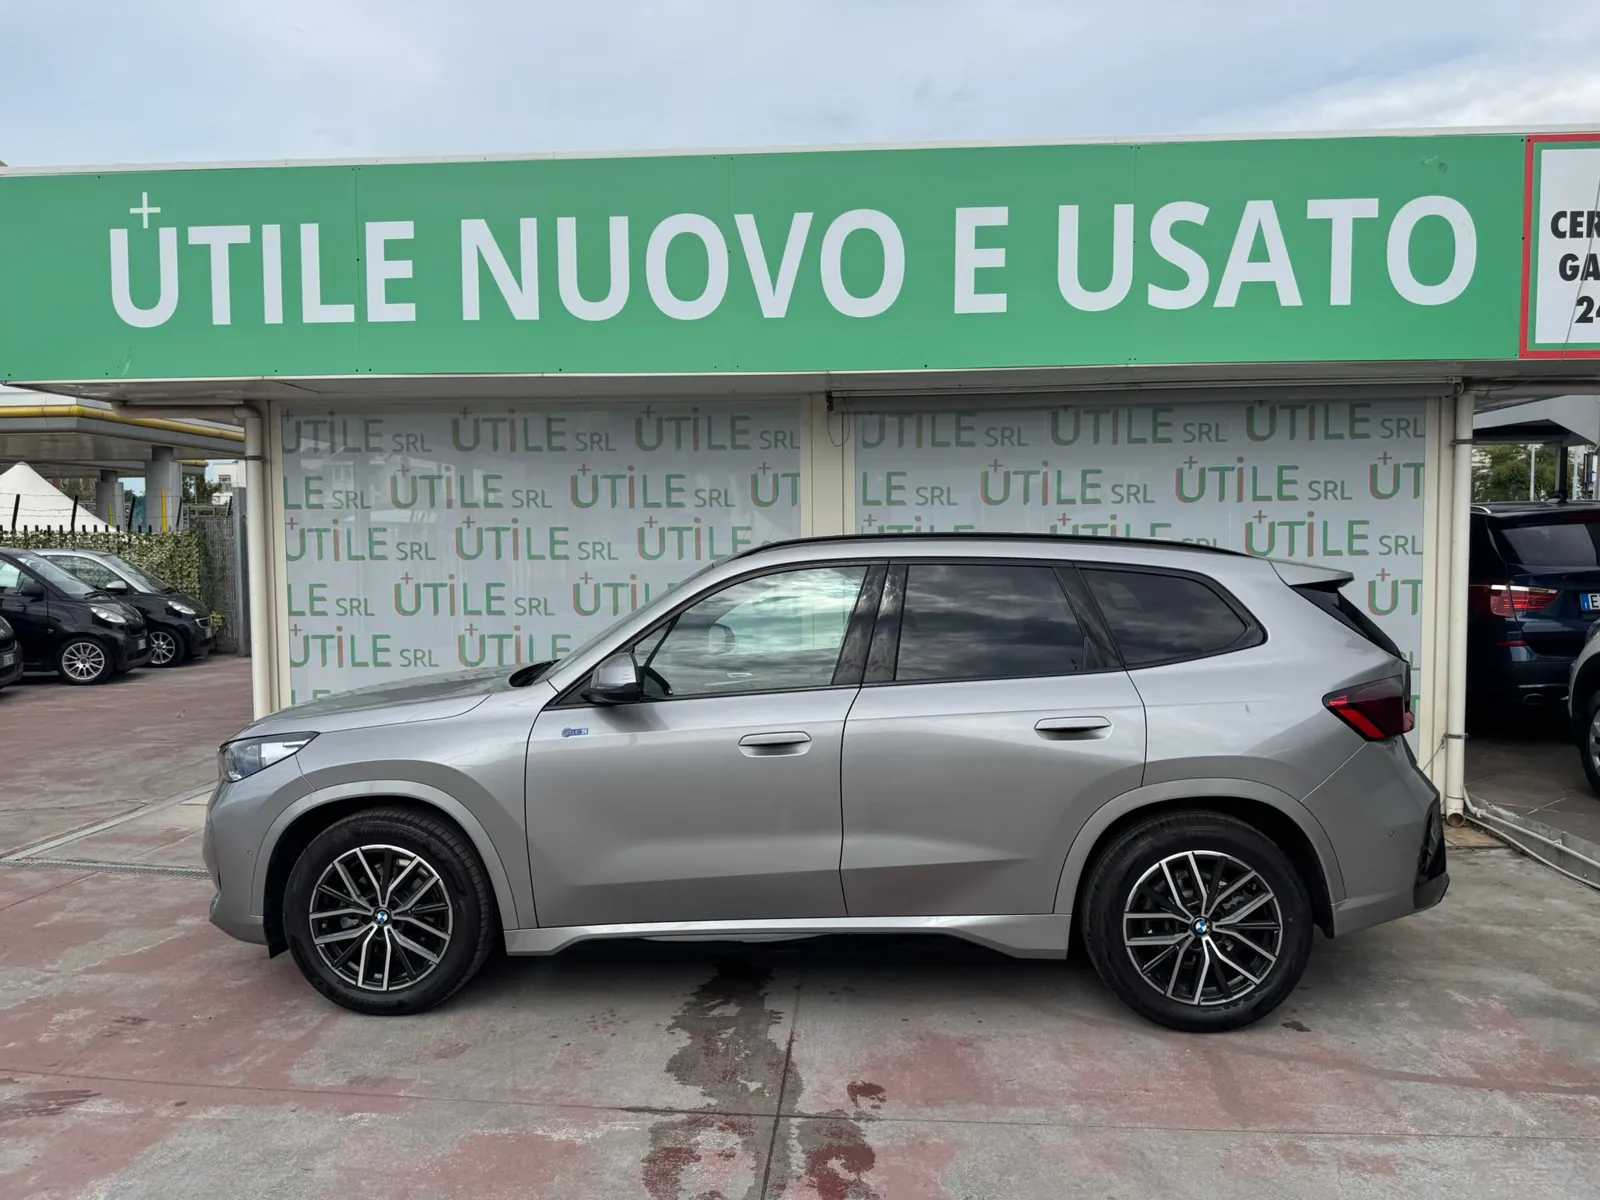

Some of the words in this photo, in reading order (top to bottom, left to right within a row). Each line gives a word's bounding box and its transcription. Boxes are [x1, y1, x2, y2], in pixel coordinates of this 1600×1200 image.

[461, 208, 906, 322] NUOVO
[953, 205, 1009, 315] E
[1057, 195, 1478, 312] USATO
[392, 433, 432, 452] SRL
[575, 432, 617, 451] SRL
[759, 430, 800, 450] SRL
[984, 427, 1028, 447] SRL
[1183, 422, 1227, 443] SRL
[1380, 418, 1425, 439] SRL
[284, 475, 323, 509] LE
[332, 490, 371, 509] SRL
[512, 489, 552, 509] SRL
[694, 488, 735, 508] SRL
[750, 462, 799, 508] UT
[862, 471, 906, 506] LE
[915, 486, 958, 506] SRL
[1111, 483, 1155, 503] SRL
[1308, 480, 1352, 500] SRL
[1369, 451, 1424, 500] UT
[397, 541, 436, 561] SRL
[578, 541, 619, 560] SRL
[1378, 535, 1423, 555] SRL
[288, 584, 328, 617] LE
[336, 598, 375, 617] SRL
[514, 597, 554, 616] SRL
[1368, 568, 1422, 616] UT
[400, 648, 439, 667] SRL
